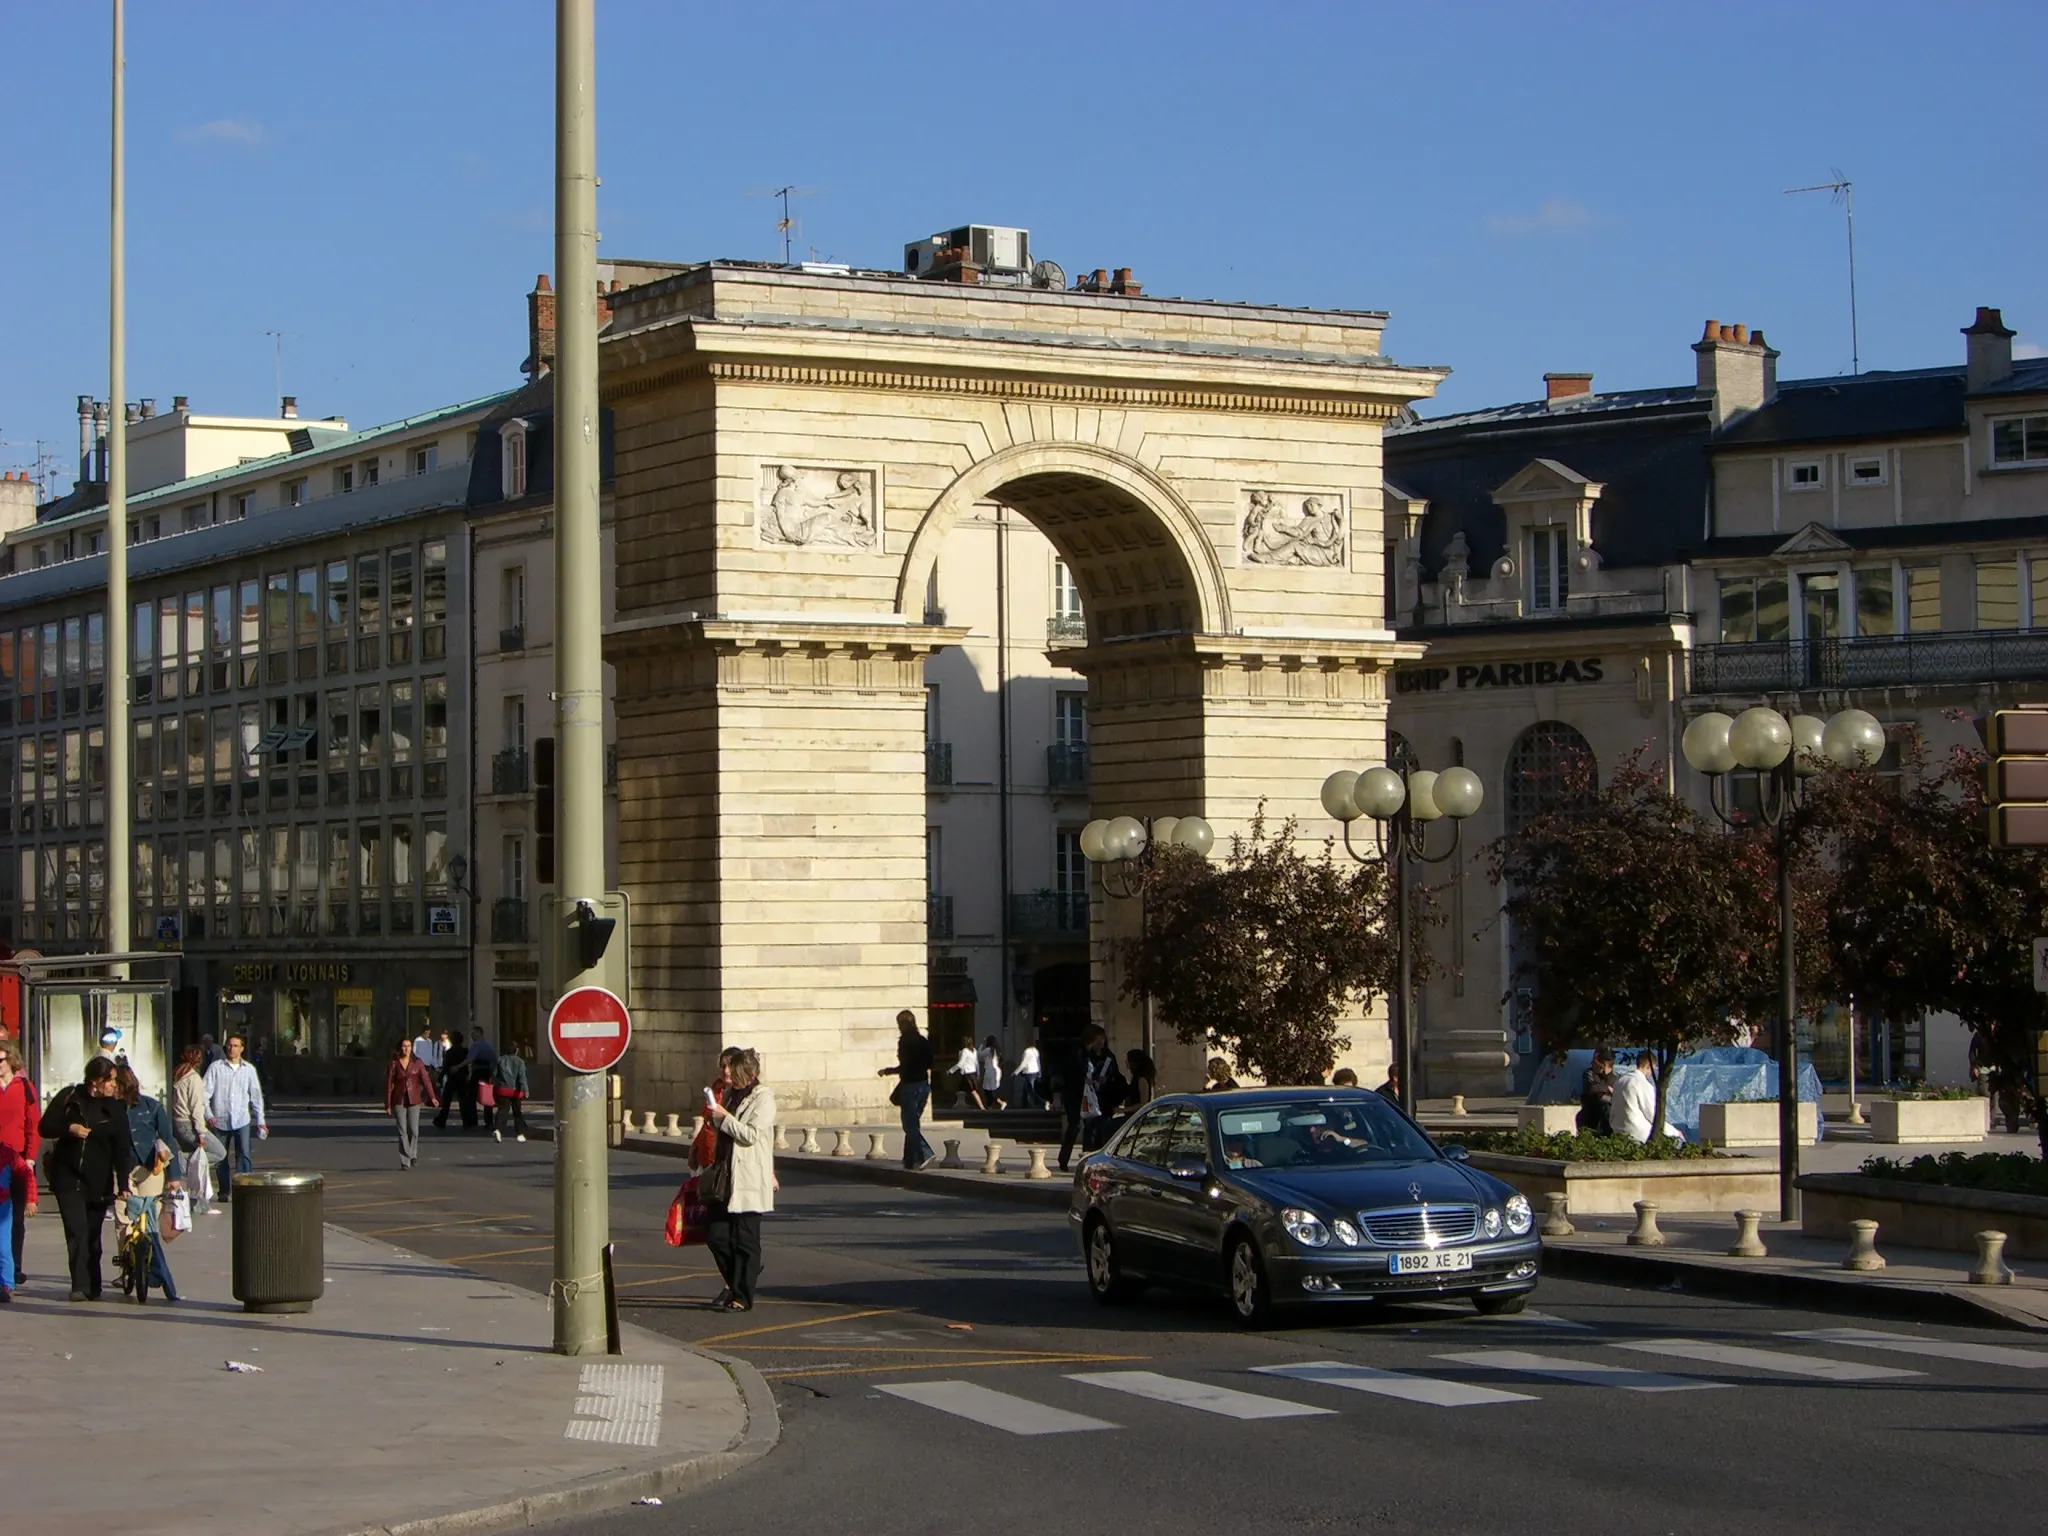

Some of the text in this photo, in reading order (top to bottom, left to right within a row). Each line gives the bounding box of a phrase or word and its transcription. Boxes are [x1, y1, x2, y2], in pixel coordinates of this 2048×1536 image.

[1456, 658, 1604, 688] PARIBAS
[437, 923, 451, 933] CL
[286, 963, 349, 983] LYONNAIS
[1399, 1252, 1470, 1270] 1892 XE 21
